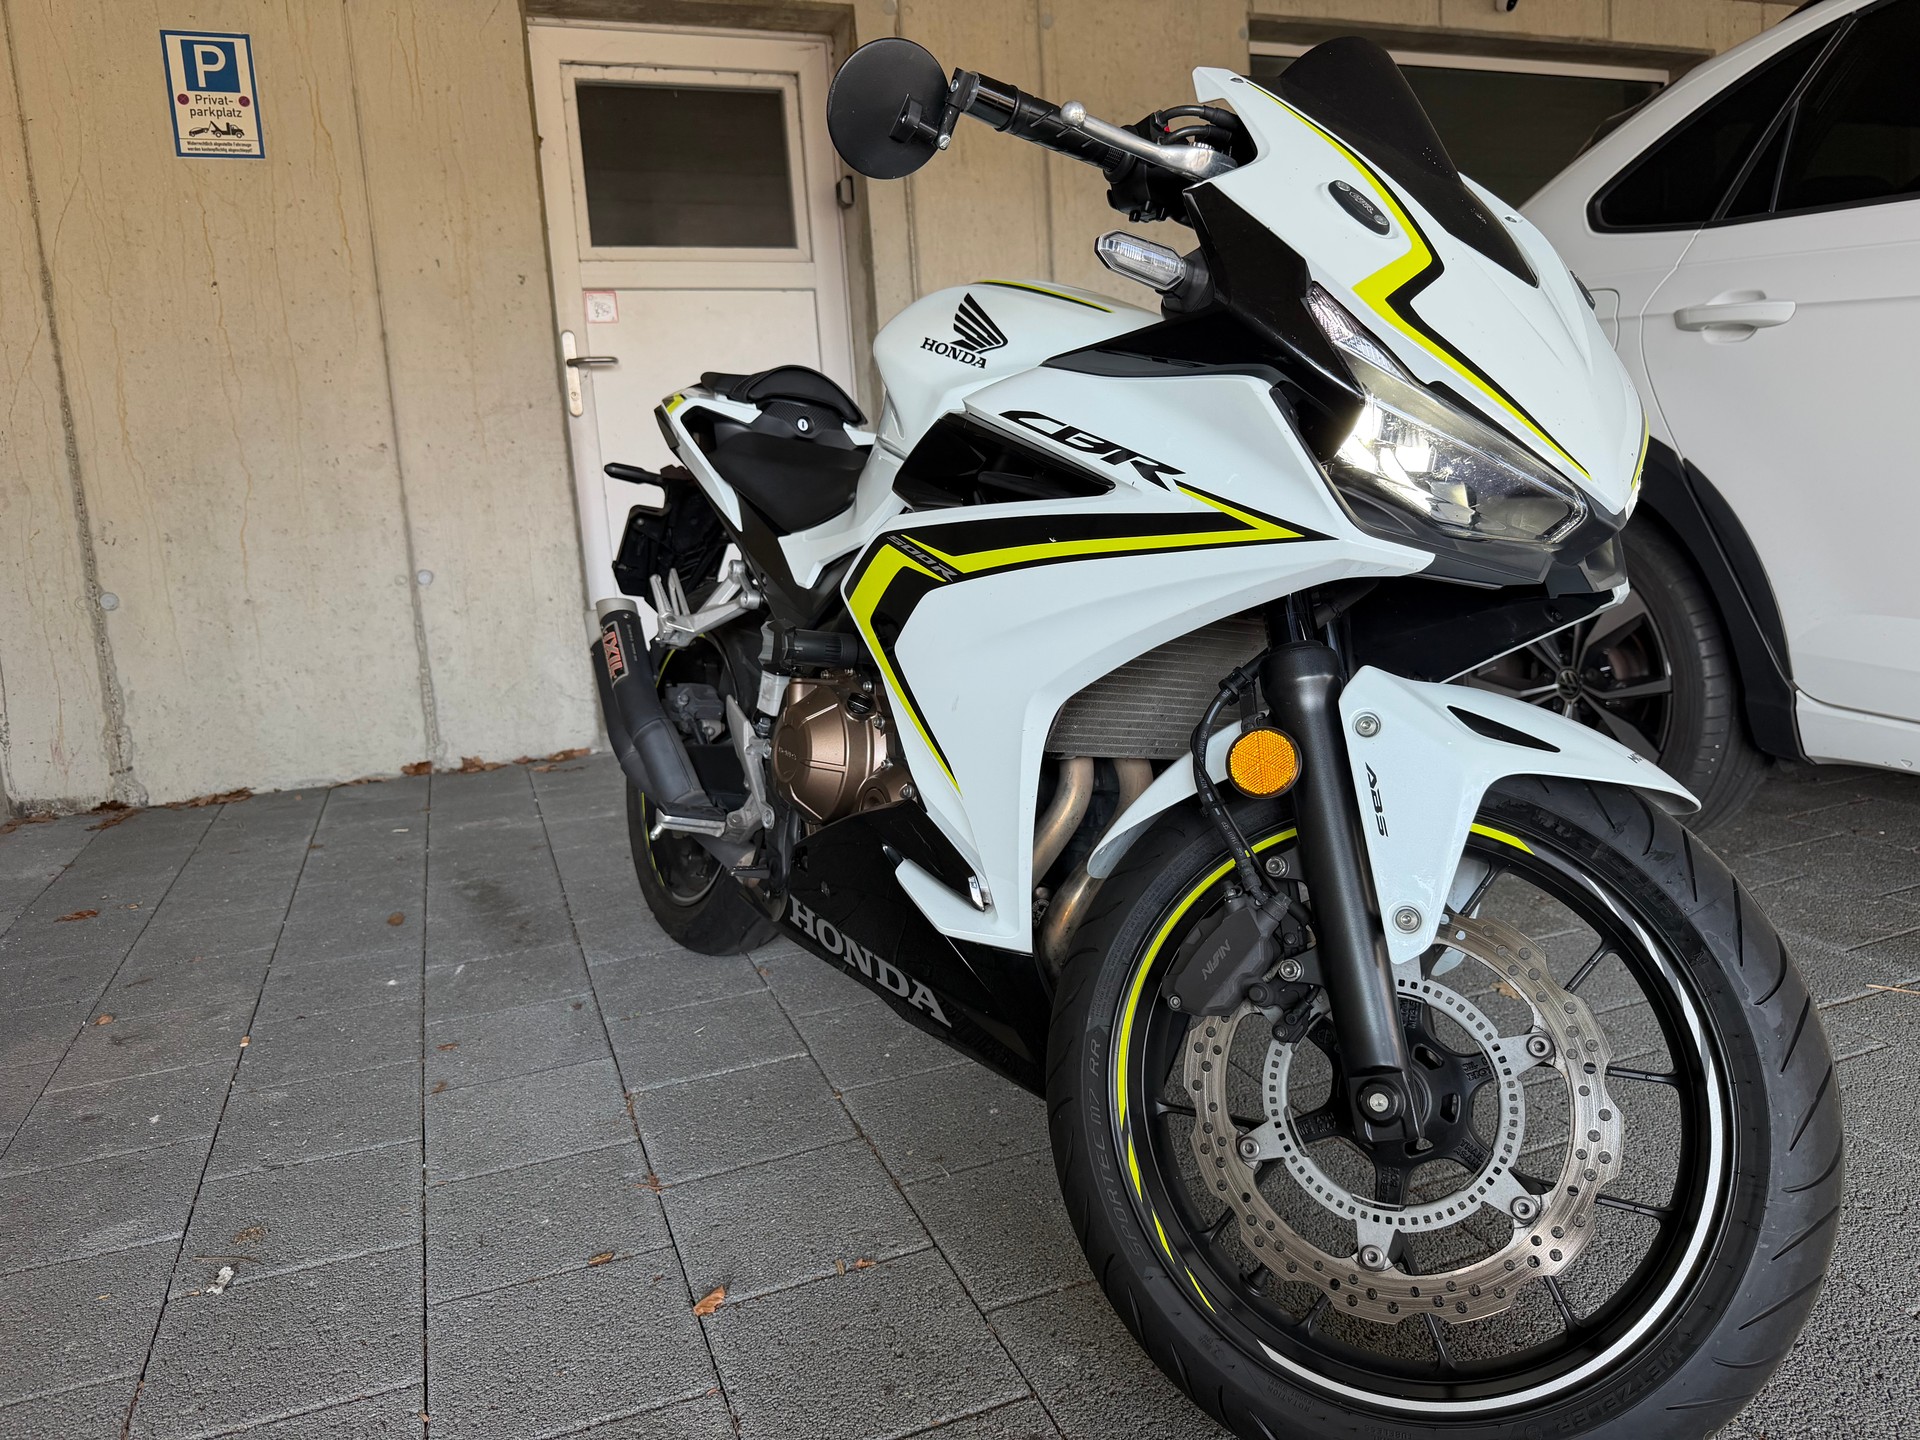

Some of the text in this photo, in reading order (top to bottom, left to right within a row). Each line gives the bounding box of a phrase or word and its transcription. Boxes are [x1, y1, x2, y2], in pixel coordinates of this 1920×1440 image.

[193, 44, 226, 88] P
[189, 107, 242, 119] parkplatz
[195, 94, 234, 106] Privat-
[920, 337, 987, 370] HONDA
[998, 410, 1187, 492] CBR
[886, 535, 958, 583] 500R
[603, 631, 624, 677] IXIL
[1364, 761, 1390, 839] ABS
[789, 894, 953, 1029] HONDA
[1087, 1038, 1102, 1079] RR
[1092, 1132, 1150, 1262] SPORTEC
[1552, 1342, 1684, 1434] METZELER
